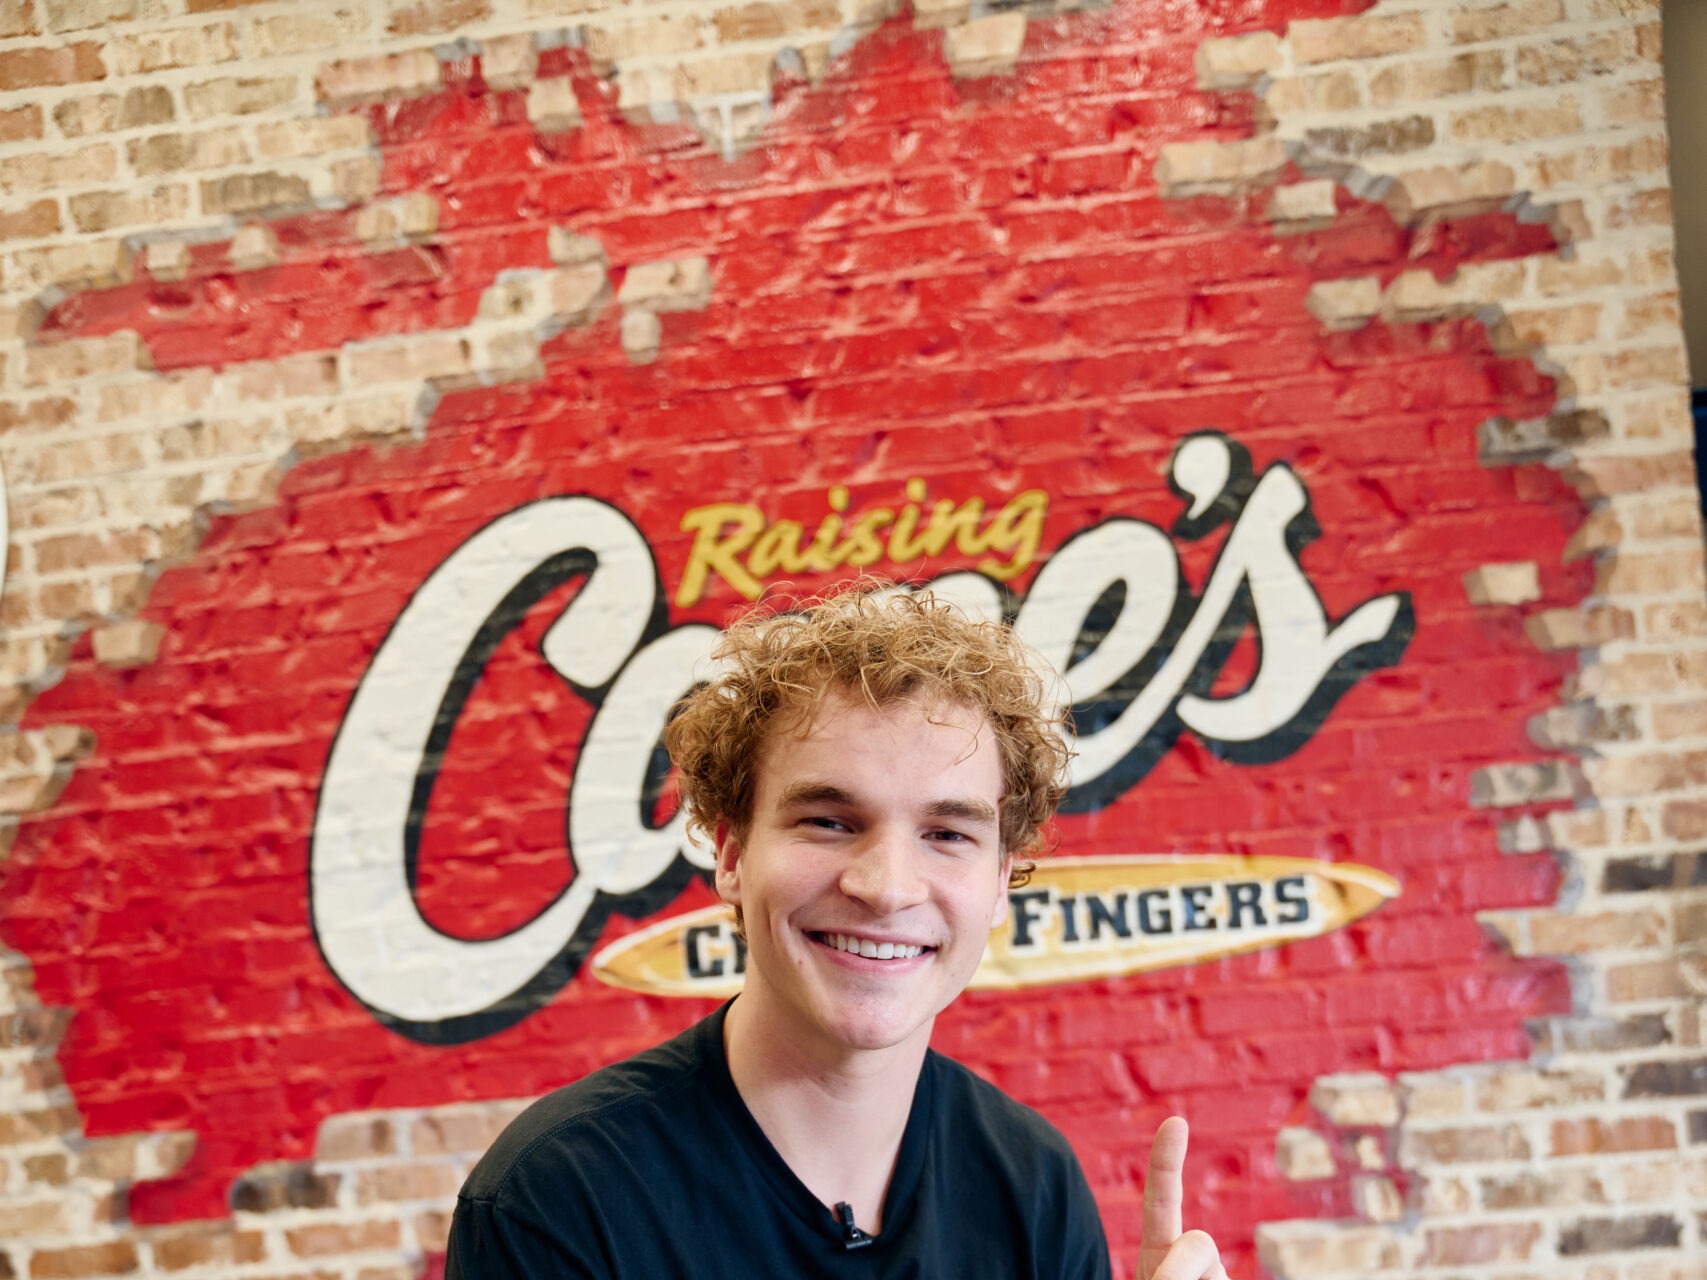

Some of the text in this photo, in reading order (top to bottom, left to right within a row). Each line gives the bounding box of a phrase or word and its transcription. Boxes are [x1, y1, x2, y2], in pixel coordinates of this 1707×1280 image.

[676, 478, 1048, 607] Raising
[310, 434, 1404, 1030] Cae's
[1009, 877, 1309, 947] FINGERS
